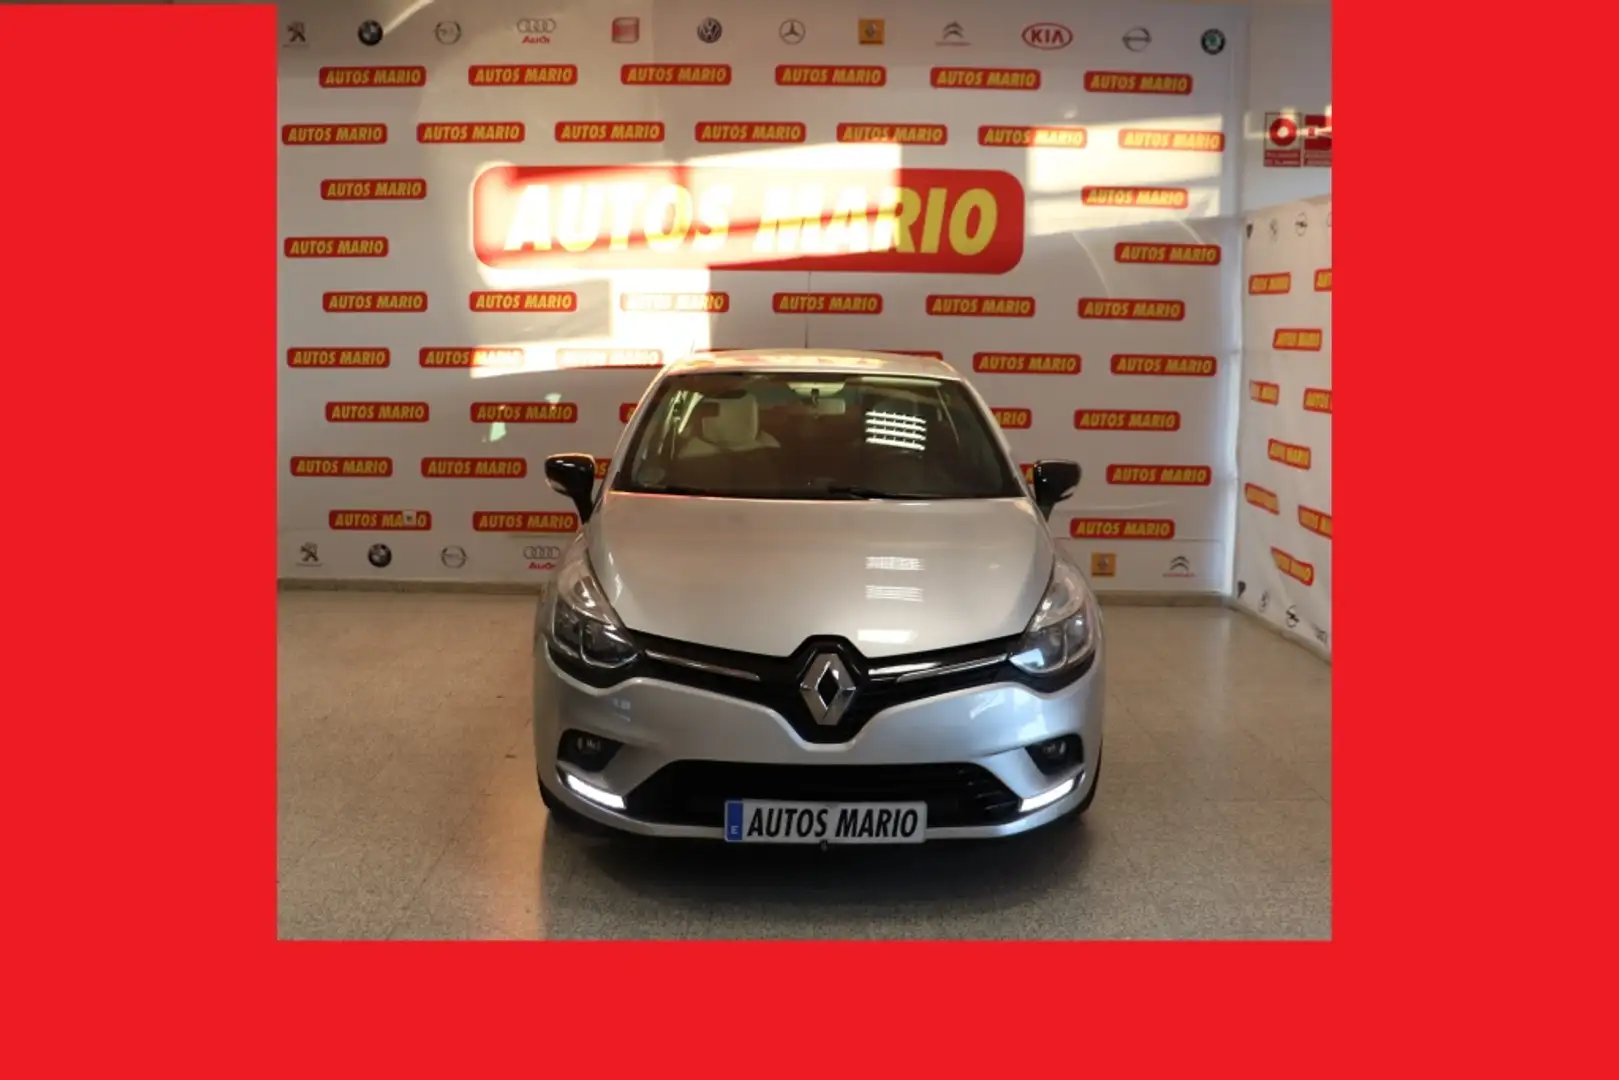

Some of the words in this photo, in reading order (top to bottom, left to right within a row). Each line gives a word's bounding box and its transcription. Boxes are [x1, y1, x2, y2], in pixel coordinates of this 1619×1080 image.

[1031, 28, 1064, 44] KIA
[325, 70, 371, 84] AUTOS
[374, 69, 421, 83] MARIO
[474, 68, 520, 83] AUTOS
[524, 68, 573, 83] MARIO
[628, 68, 674, 83] AUTOS
[678, 68, 727, 83] MARIO
[782, 69, 828, 83] AUTOS
[832, 69, 882, 84] MARIO
[937, 72, 983, 86] AUTOS
[987, 73, 1036, 88] MARIO
[1090, 75, 1137, 91] AUTOS
[1140, 77, 1188, 92] MARIO
[288, 128, 332, 142] AUTOS
[336, 127, 382, 141] MARIO
[423, 126, 469, 140] AUTOS
[472, 126, 520, 140] MARIO
[560, 125, 607, 139] AUTOS
[610, 125, 660, 139] MARIO
[702, 125, 748, 140] AUTOS
[752, 125, 801, 140] MARIO
[843, 127, 889, 142] AUTOS
[893, 128, 943, 142] MARIO
[984, 129, 1031, 145] AUTOS
[1123, 132, 1169, 147] AUTOS
[1172, 134, 1220, 149] MARIO
[327, 183, 371, 197] AUTOS
[374, 182, 422, 197] MARIO
[1087, 189, 1132, 204] AUTOS
[1135, 191, 1184, 206] MARIO
[504, 183, 733, 252] AUTOS
[752, 187, 998, 256] MARIO
[290, 240, 333, 255] AUTOS
[337, 240, 384, 255] MARIO
[1120, 246, 1166, 261] AUTOS
[1169, 247, 1216, 263] MARIO
[329, 295, 372, 309] AUTOS
[376, 295, 423, 309] MARIO
[475, 295, 520, 309] AUTOS
[524, 295, 572, 309] MARIO
[779, 295, 825, 310] AUTOS
[829, 296, 878, 312] MARIO
[932, 298, 978, 313] AUTOS
[981, 299, 1031, 315] MARIO
[1084, 302, 1129, 317] AUTOS
[1133, 303, 1181, 318] MARIO
[294, 352, 336, 365] AUTOS
[339, 352, 386, 365] MARIO
[425, 352, 470, 365] AUTOS
[979, 355, 1025, 370] AUTOS
[1028, 355, 1076, 372] MARIO
[1116, 358, 1162, 373] AUTOS
[1165, 359, 1213, 374] MARIO
[331, 406, 374, 420] AUTOS
[378, 406, 425, 420] MARIO
[477, 406, 521, 421] AUTOS
[525, 406, 573, 421] MARIO
[1079, 412, 1125, 428] AUTOS
[1128, 413, 1176, 429] MARIO
[296, 460, 338, 475] AUTOS
[342, 460, 388, 475] MARIO
[428, 461, 472, 475] AUTOS
[476, 461, 522, 476] MARIO
[1113, 468, 1157, 483] AUTOS
[1160, 468, 1208, 483] MARIO
[335, 513, 378, 527] AUTOS
[382, 514, 427, 528] MAO
[480, 515, 523, 529] AUTOS
[527, 515, 574, 530] MARIO
[1076, 521, 1120, 536] AUTOS
[1123, 522, 1170, 537] MARIO
[747, 807, 829, 838] AUTOS
[834, 808, 919, 838] MARIO
